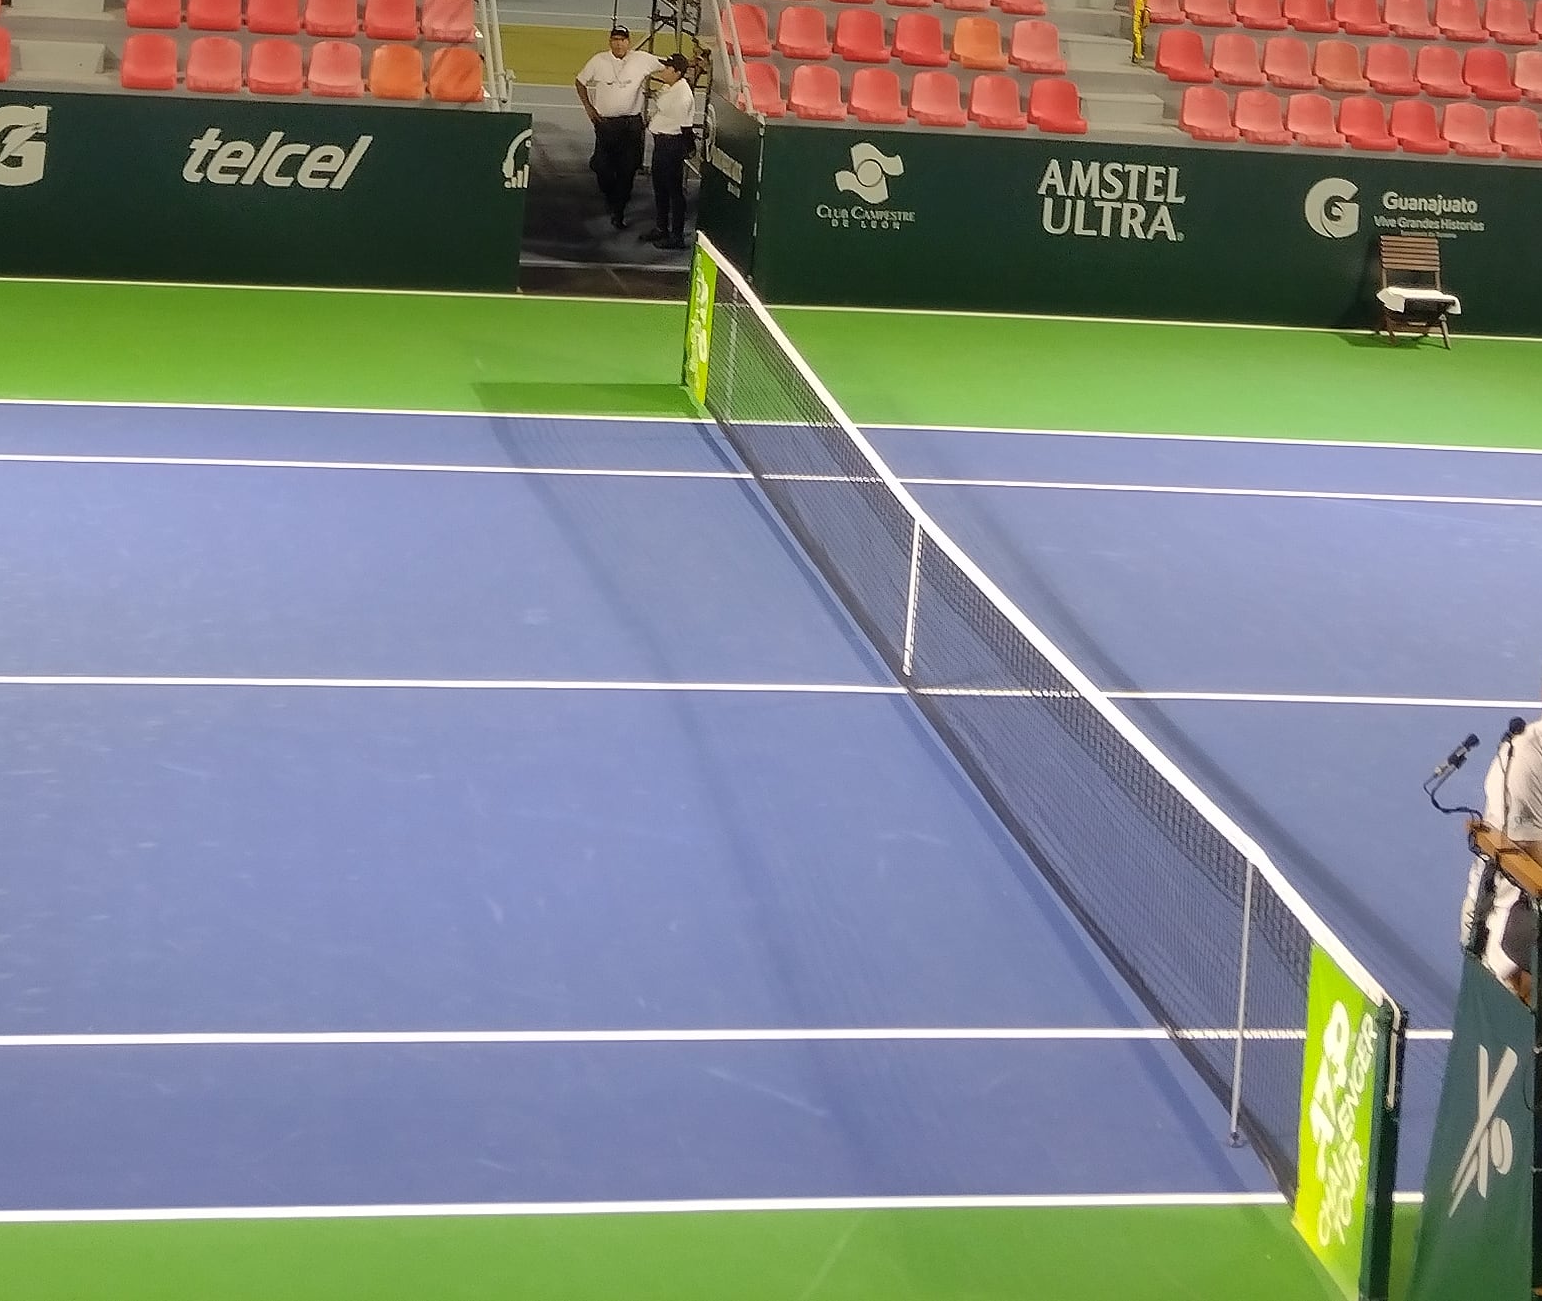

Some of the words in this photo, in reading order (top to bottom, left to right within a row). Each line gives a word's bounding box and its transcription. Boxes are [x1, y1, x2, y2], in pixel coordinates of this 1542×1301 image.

[182, 128, 373, 190] telcel
[1037, 158, 1187, 204] AMSTEL
[1042, 197, 1178, 242] ULTRA
[1382, 191, 1478, 216] Guanajuato
[1398, 216, 1440, 229] Grandes
[1440, 218, 1485, 232] Historias
